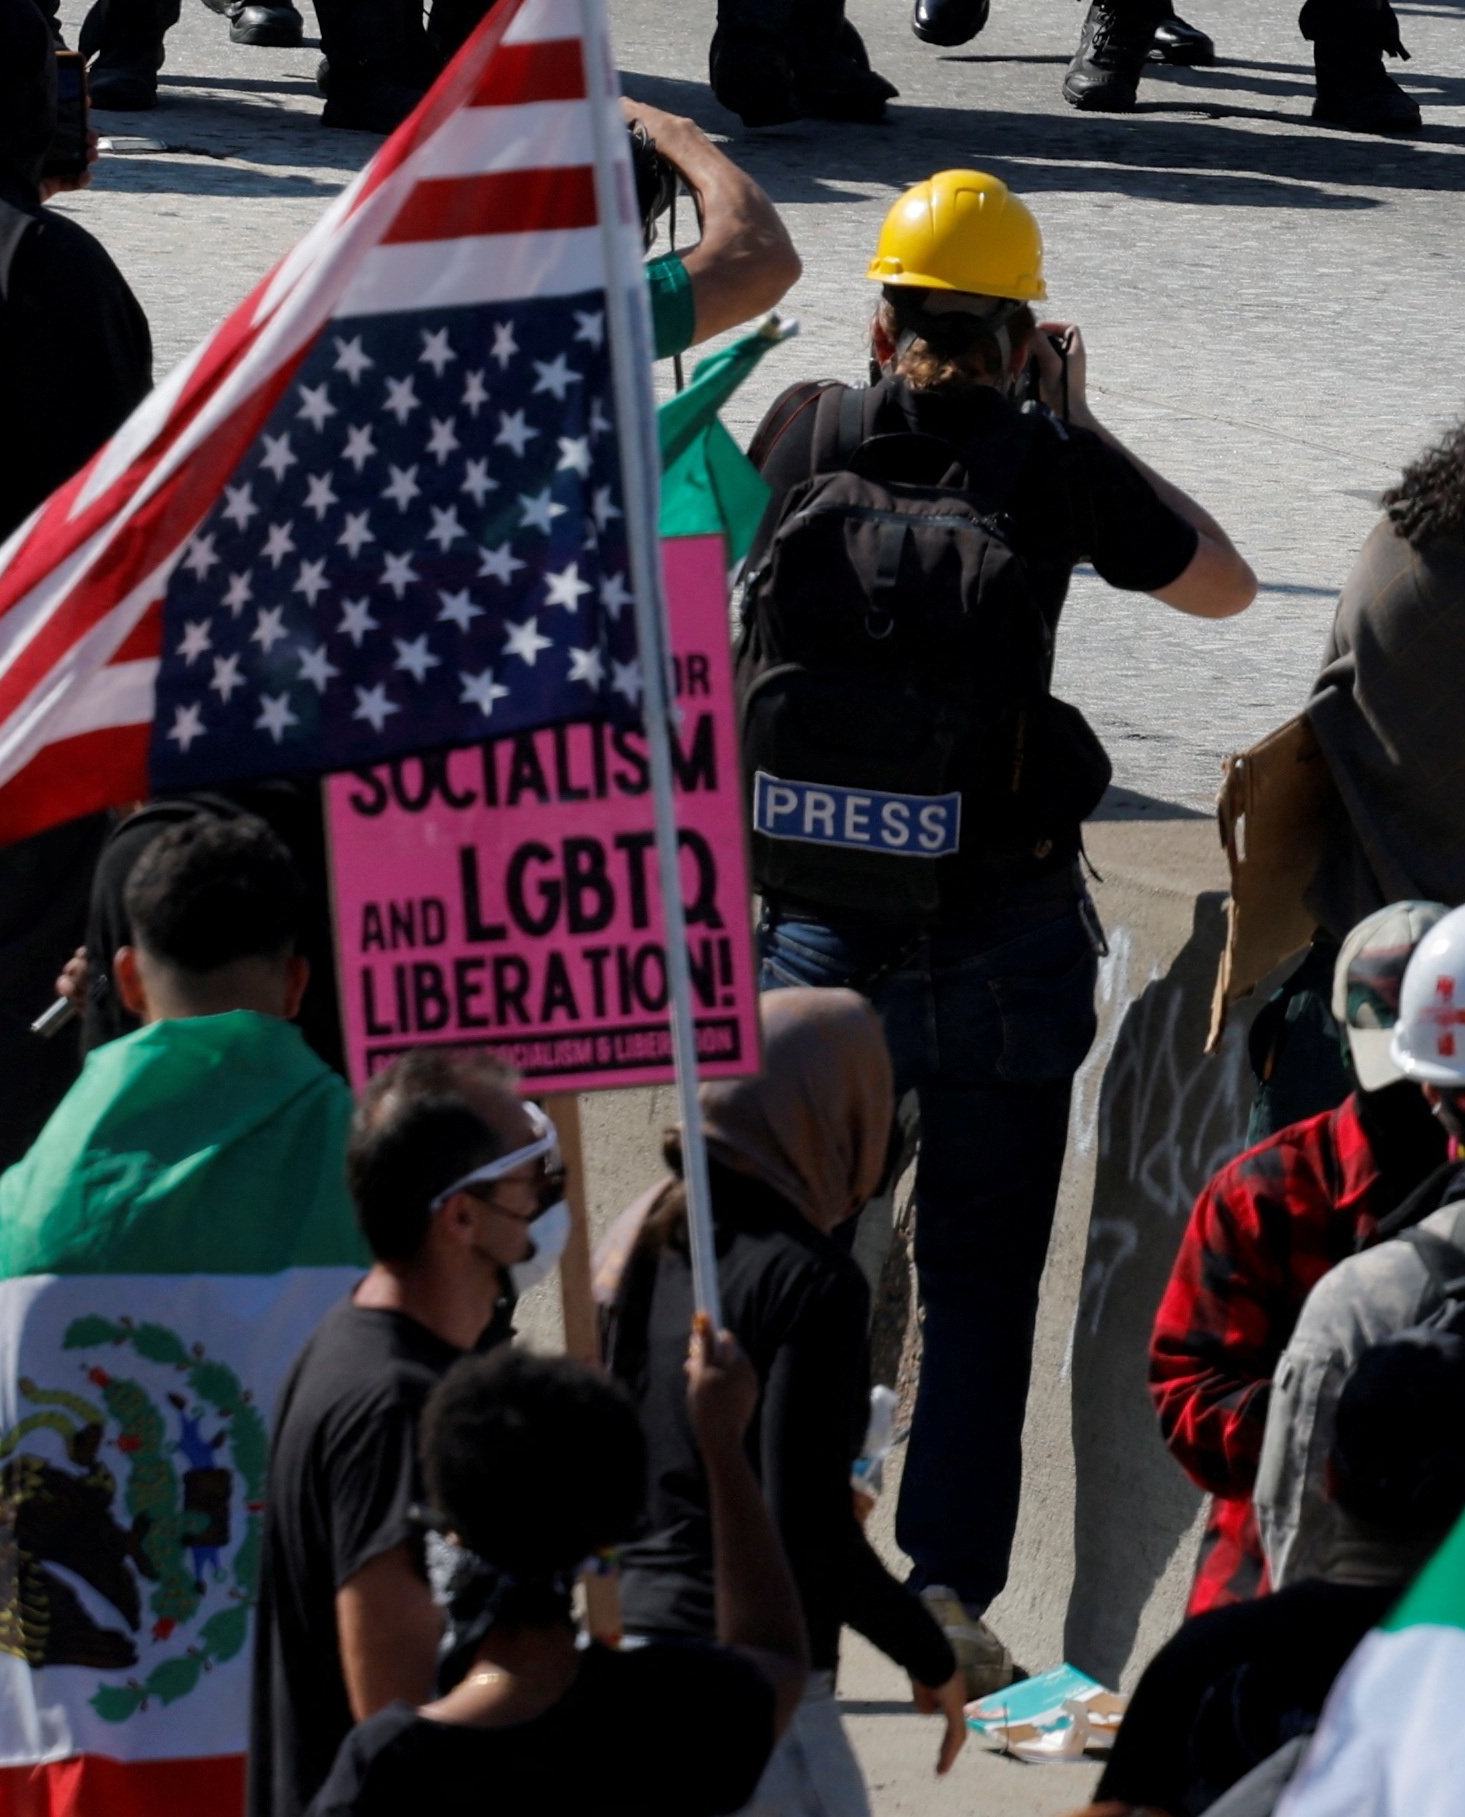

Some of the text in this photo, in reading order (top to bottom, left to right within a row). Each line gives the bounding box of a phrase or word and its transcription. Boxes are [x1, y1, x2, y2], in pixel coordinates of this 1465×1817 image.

[765, 784, 948, 850] PRESS
[361, 828, 725, 953] AND LGBTQ
[361, 936, 736, 1037] LIBERATION!
